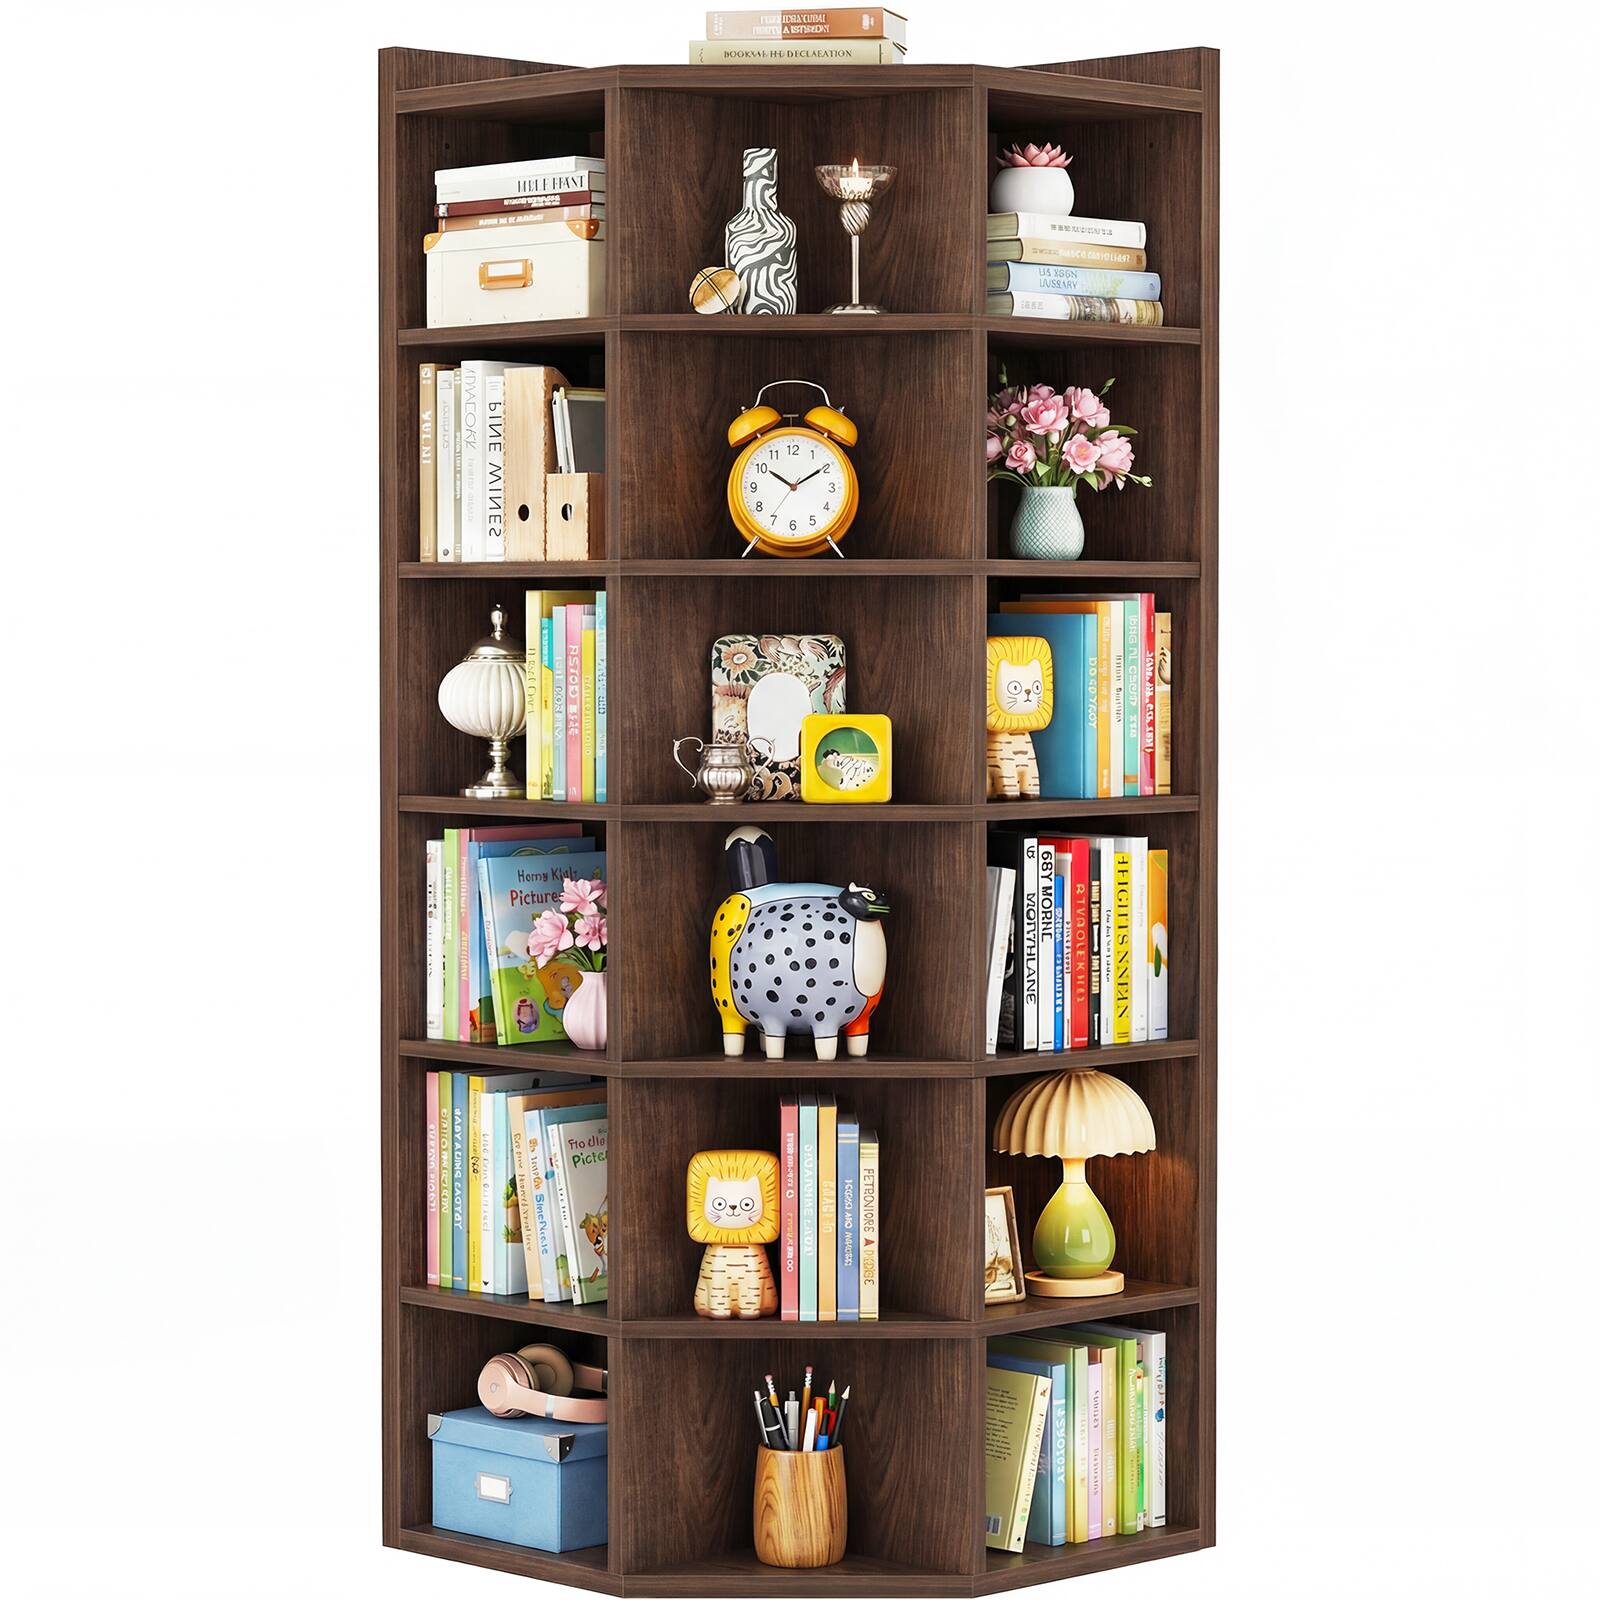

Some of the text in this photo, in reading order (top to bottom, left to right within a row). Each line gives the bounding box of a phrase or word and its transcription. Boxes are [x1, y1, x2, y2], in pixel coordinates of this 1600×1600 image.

[769, 450, 779, 460] 11
[787, 445, 800, 455] 12
[755, 463, 768, 474] 10
[822, 463, 831, 474] 2
[750, 482, 757, 493] 9
[828, 482, 836, 493] 3
[755, 501, 763, 512] 8
[823, 501, 830, 511] 4
[770, 515, 778, 526] 7
[789, 520, 797, 531] 6
[809, 515, 817, 526] 5
